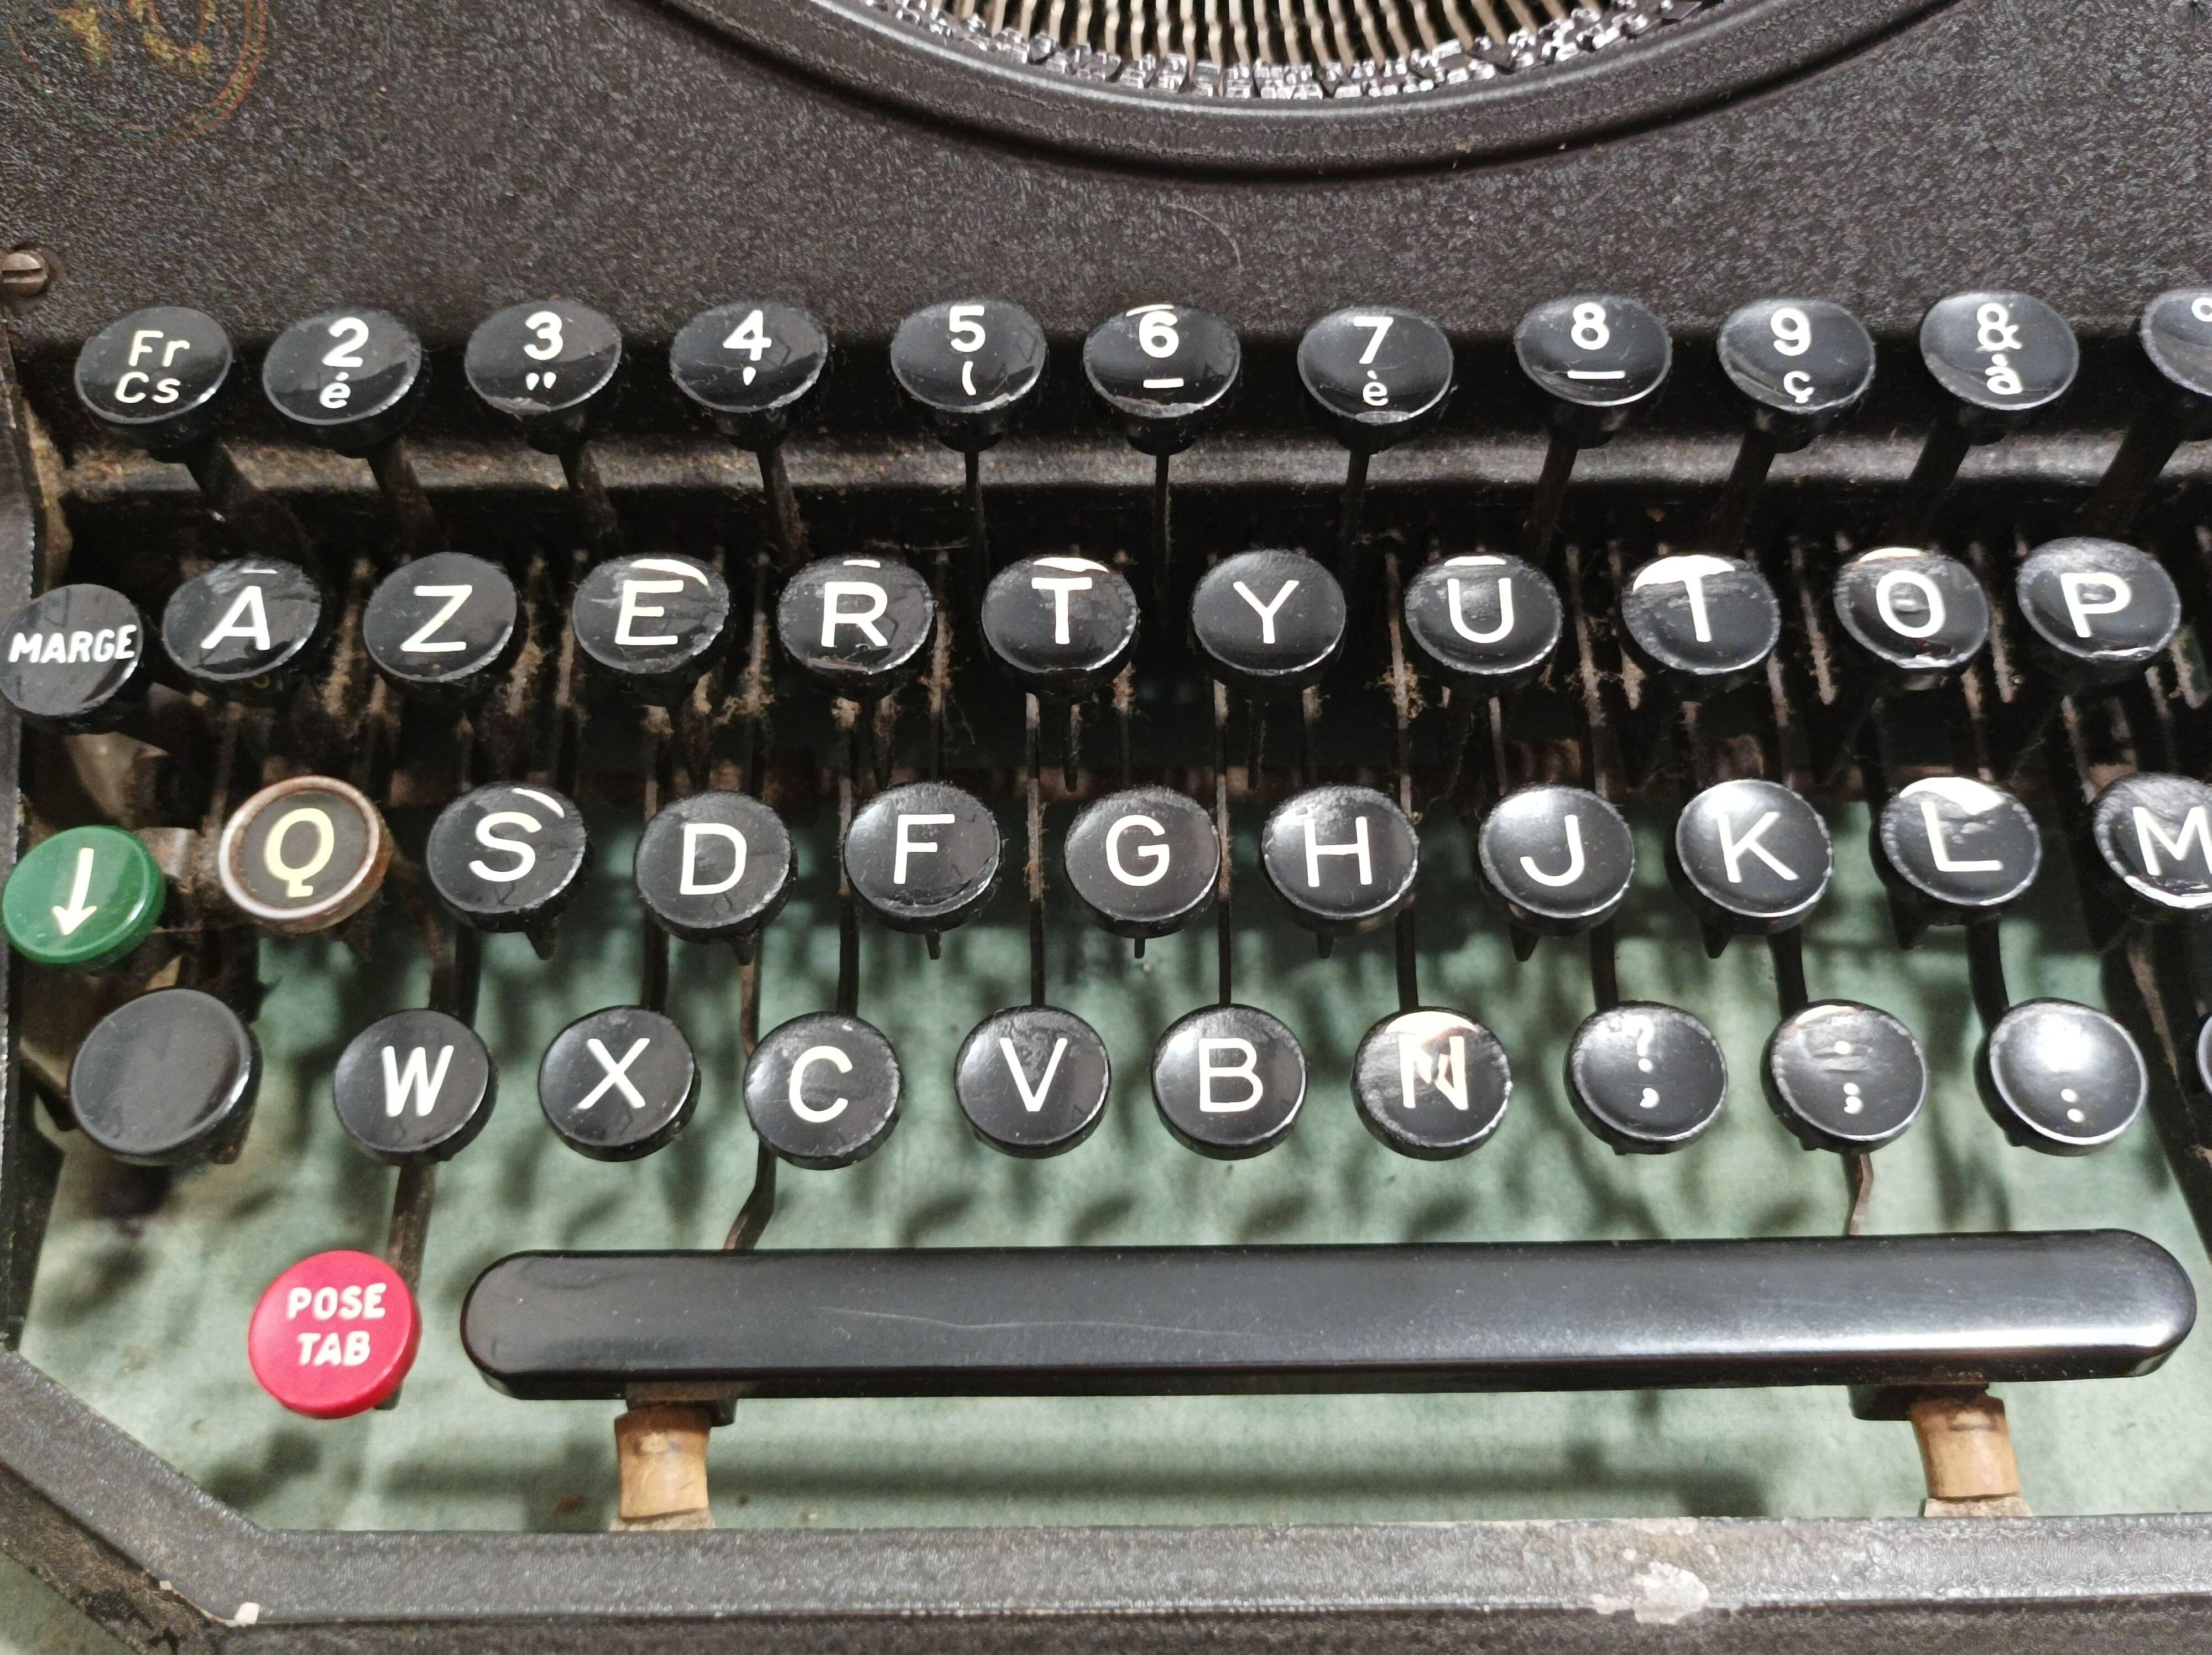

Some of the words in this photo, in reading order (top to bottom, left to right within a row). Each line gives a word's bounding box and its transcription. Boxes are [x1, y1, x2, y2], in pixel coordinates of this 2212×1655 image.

[128, 329, 191, 368] Fr
[321, 316, 369, 368] 2
[523, 310, 564, 361] 3
[722, 309, 773, 362] 4
[948, 304, 986, 353] 5
[1138, 311, 1180, 358] 6
[1353, 315, 1394, 365] 7
[1570, 301, 1610, 351] 8
[1770, 307, 1812, 356] 9
[1976, 303, 2022, 351] &
[114, 371, 181, 404] Cs
[319, 371, 351, 409] é
[961, 360, 977, 396] (
[1362, 369, 1389, 407] è
[1783, 370, 1815, 404] ç
[200, 585, 271, 651] A
[400, 584, 473, 653] Z
[614, 579, 685, 646] E
[821, 581, 888, 648] R
[1030, 576, 1093, 645] T
[1232, 579, 1300, 645] Y
[1447, 577, 1514, 644] U
[1876, 570, 1945, 638] O
[2060, 572, 2132, 638] P
[8, 624, 138, 665] MARGE
[264, 808, 335, 898] Q
[468, 811, 542, 883] S
[679, 821, 748, 896] D
[893, 813, 956, 885] F
[1105, 814, 1171, 887] G
[1304, 816, 1373, 887] H
[1520, 814, 1585, 886] J
[1716, 811, 1799, 883] K
[1921, 801, 2004, 872] L
[2132, 806, 2212, 876] M
[381, 1044, 455, 1117] W
[576, 1037, 651, 1110] X
[789, 1045, 853, 1123] C
[999, 1037, 1068, 1112] V
[1199, 1038, 1264, 1112] B
[1399, 1034, 1469, 1110] N
[286, 1282, 387, 1321] POSE
[297, 1330, 371, 1367] TAB
